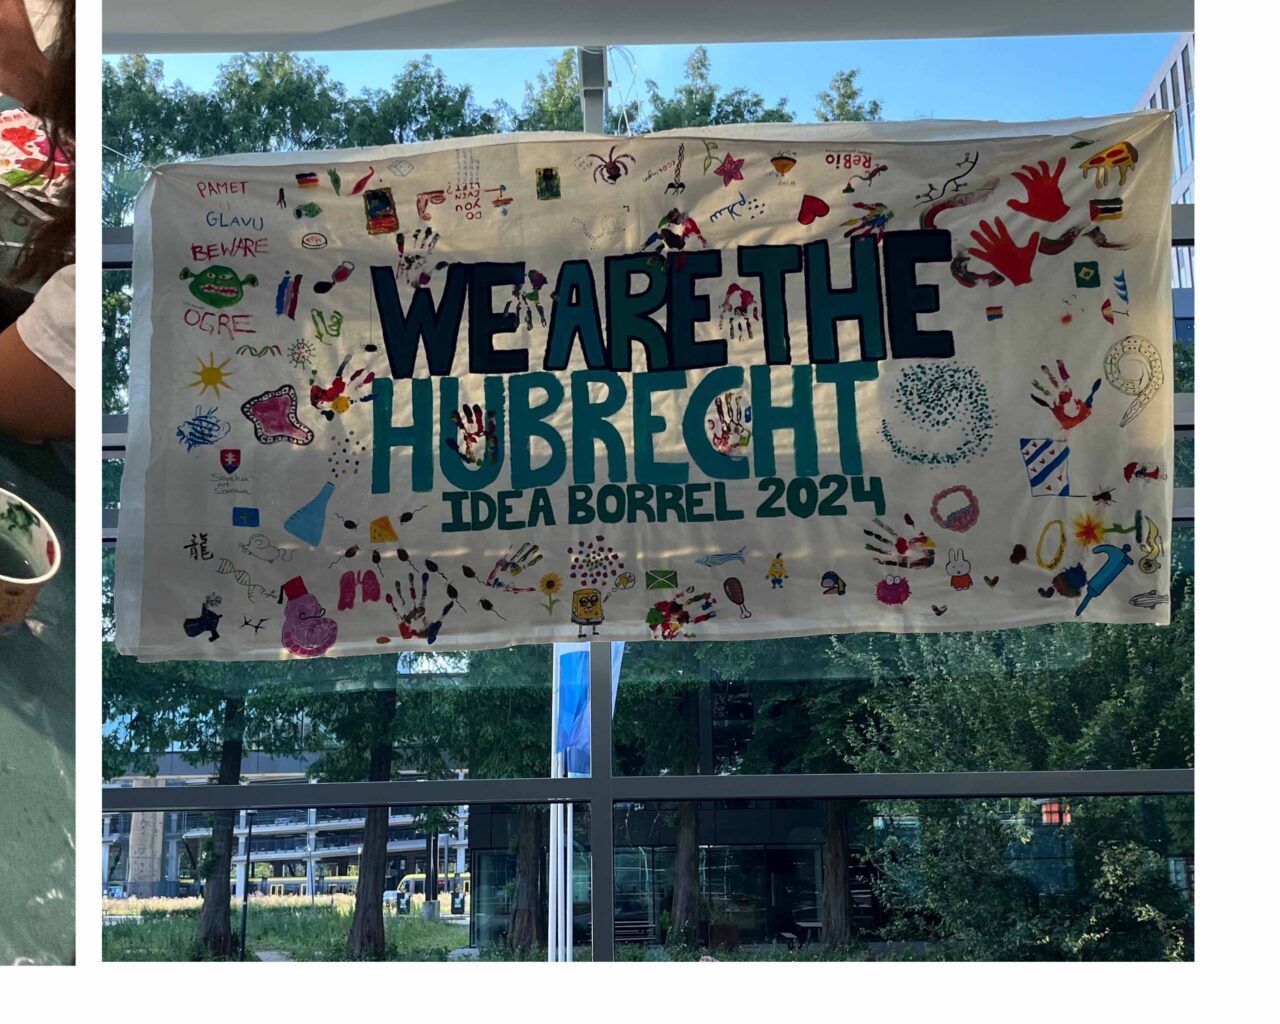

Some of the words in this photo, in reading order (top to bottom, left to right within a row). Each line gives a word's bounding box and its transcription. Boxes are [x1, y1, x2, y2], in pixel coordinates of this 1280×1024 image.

[825, 154, 872, 169] ReBio
[196, 180, 249, 198] PAMET
[455, 198, 481, 212] YOU
[206, 211, 264, 231] GLAVU
[190, 237, 270, 262] BEWARE
[370, 262, 529, 378] WE
[543, 249, 729, 373] ARE
[736, 229, 956, 365] THE
[184, 308, 256, 340] OGRE
[370, 361, 879, 495] HUBRECHT
[441, 486, 558, 532] IDEA
[568, 480, 745, 527] BORREL
[756, 474, 886, 518] 2024
